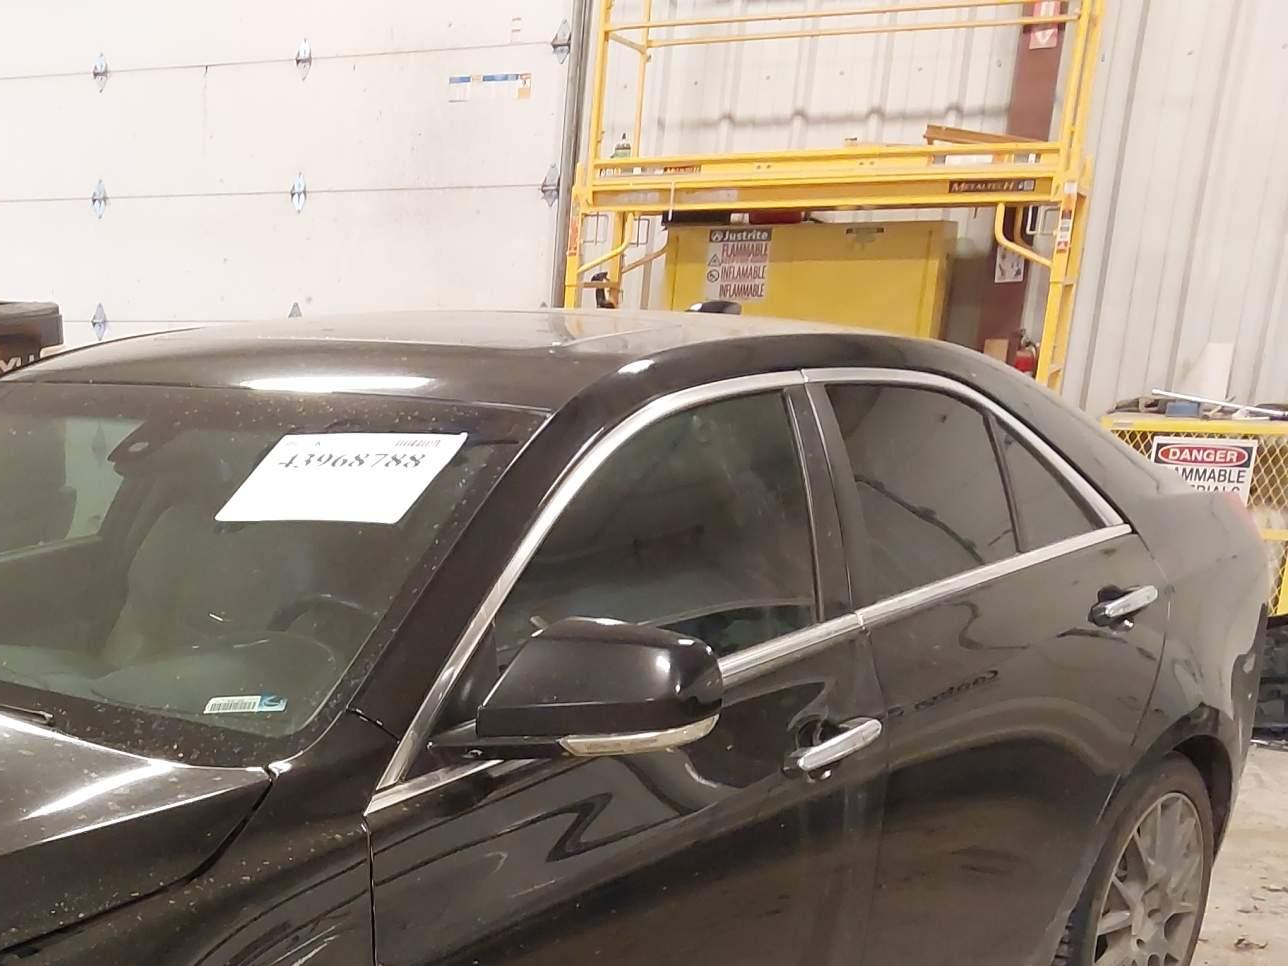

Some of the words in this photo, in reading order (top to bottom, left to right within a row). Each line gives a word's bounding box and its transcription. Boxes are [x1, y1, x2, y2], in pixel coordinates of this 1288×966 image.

[723, 230, 769, 240] Justrite
[722, 243, 768, 257] FLAMMABLE
[720, 265, 766, 279] INFLAMABLE
[719, 283, 765, 297] INFLAMMABLE
[278, 453, 426, 468] 43968788
[1168, 448, 1239, 462] DANGER
[1175, 466, 1247, 484] MMABLE
